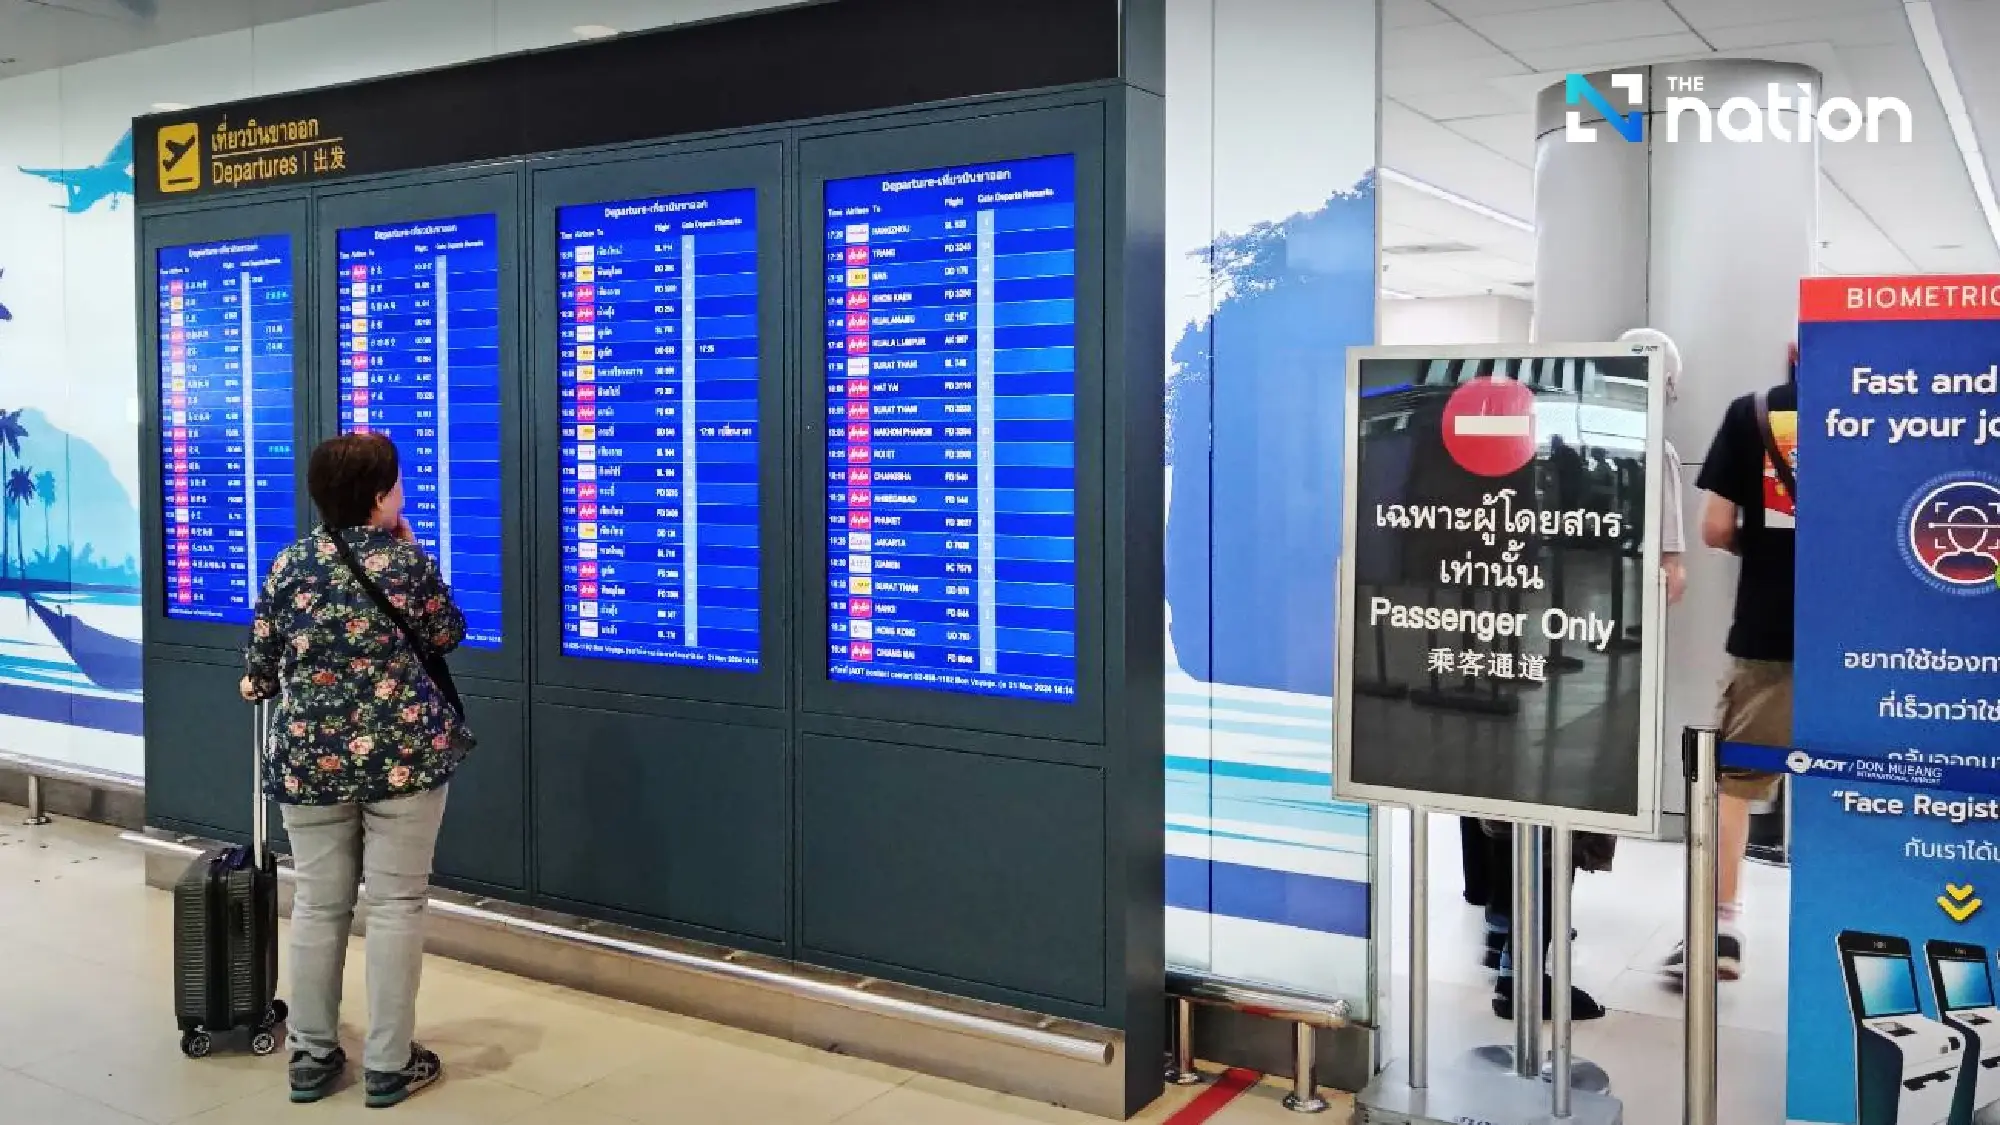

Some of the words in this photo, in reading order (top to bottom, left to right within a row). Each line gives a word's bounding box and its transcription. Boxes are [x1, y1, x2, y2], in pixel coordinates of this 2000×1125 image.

[212, 113, 319, 152] เที่ยวบินขาออก
[211, 155, 298, 188] Departures
[314, 145, 346, 174] 出发
[1852, 367, 1918, 394] Fast
[1931, 365, 1998, 394] and
[1826, 408, 1875, 437] for
[1888, 415, 1966, 444] your
[874, 472, 912, 481] CHANGSHA
[874, 516, 901, 525] PHUKET
[1375, 490, 1623, 546] เฉพาะผู้โดยสาร
[1440, 540, 1544, 590] เท่านั้น
[1370, 597, 1528, 638] Passenger
[1541, 608, 1615, 652] Only
[1427, 647, 1547, 682] 乘客通道
[1844, 648, 2000, 673] อยากใช้ช่องท
[1811, 759, 1847, 771] AOT
[1857, 760, 1884, 771] DON
[1888, 763, 1943, 778] MUEANG
[1914, 794, 2000, 823] Regist
